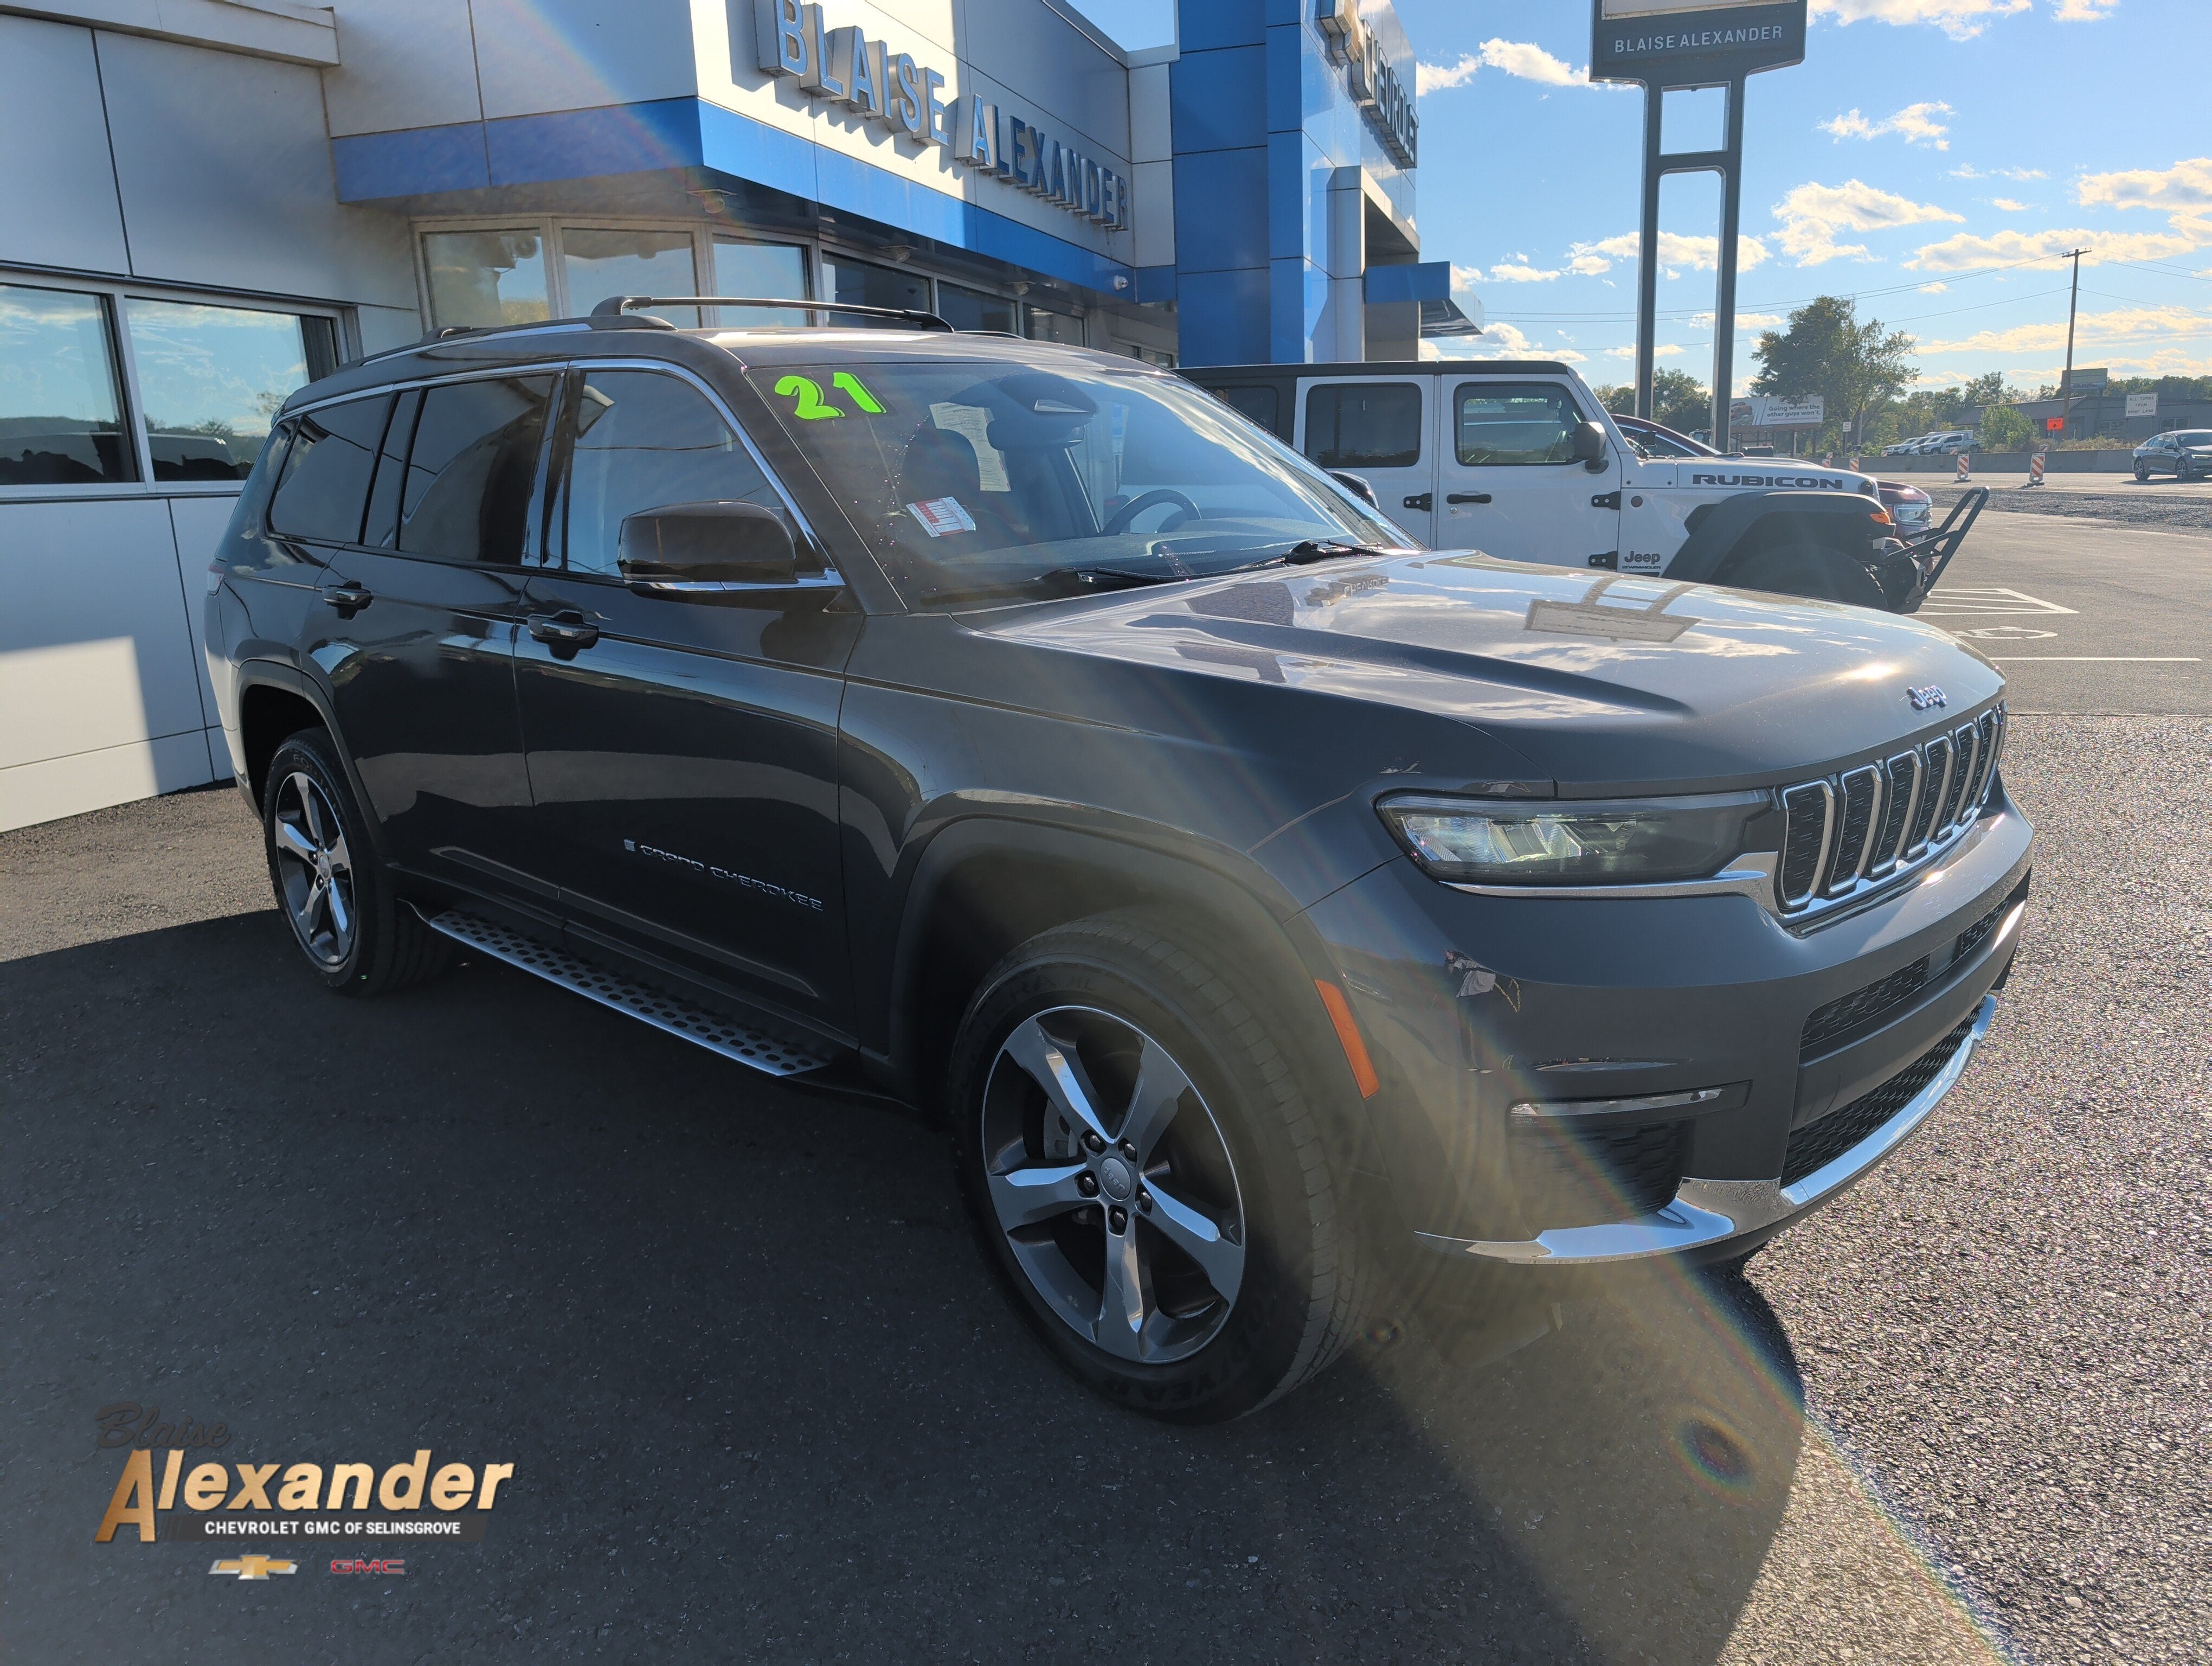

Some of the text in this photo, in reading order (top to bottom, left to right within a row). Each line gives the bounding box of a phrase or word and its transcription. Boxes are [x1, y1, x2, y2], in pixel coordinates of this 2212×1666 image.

[1615, 25, 1783, 53] BLAISE ALEXANDER
[773, 0, 1129, 232] BLAISE ALEXANDER
[774, 371, 888, 421] 21
[1692, 474, 1843, 489] RUBICON
[1624, 550, 1661, 565] Jeep
[1906, 685, 1947, 709] Jeep
[710, 866, 824, 912] CHEROKEE
[1103, 1165, 1126, 1193] Jeep
